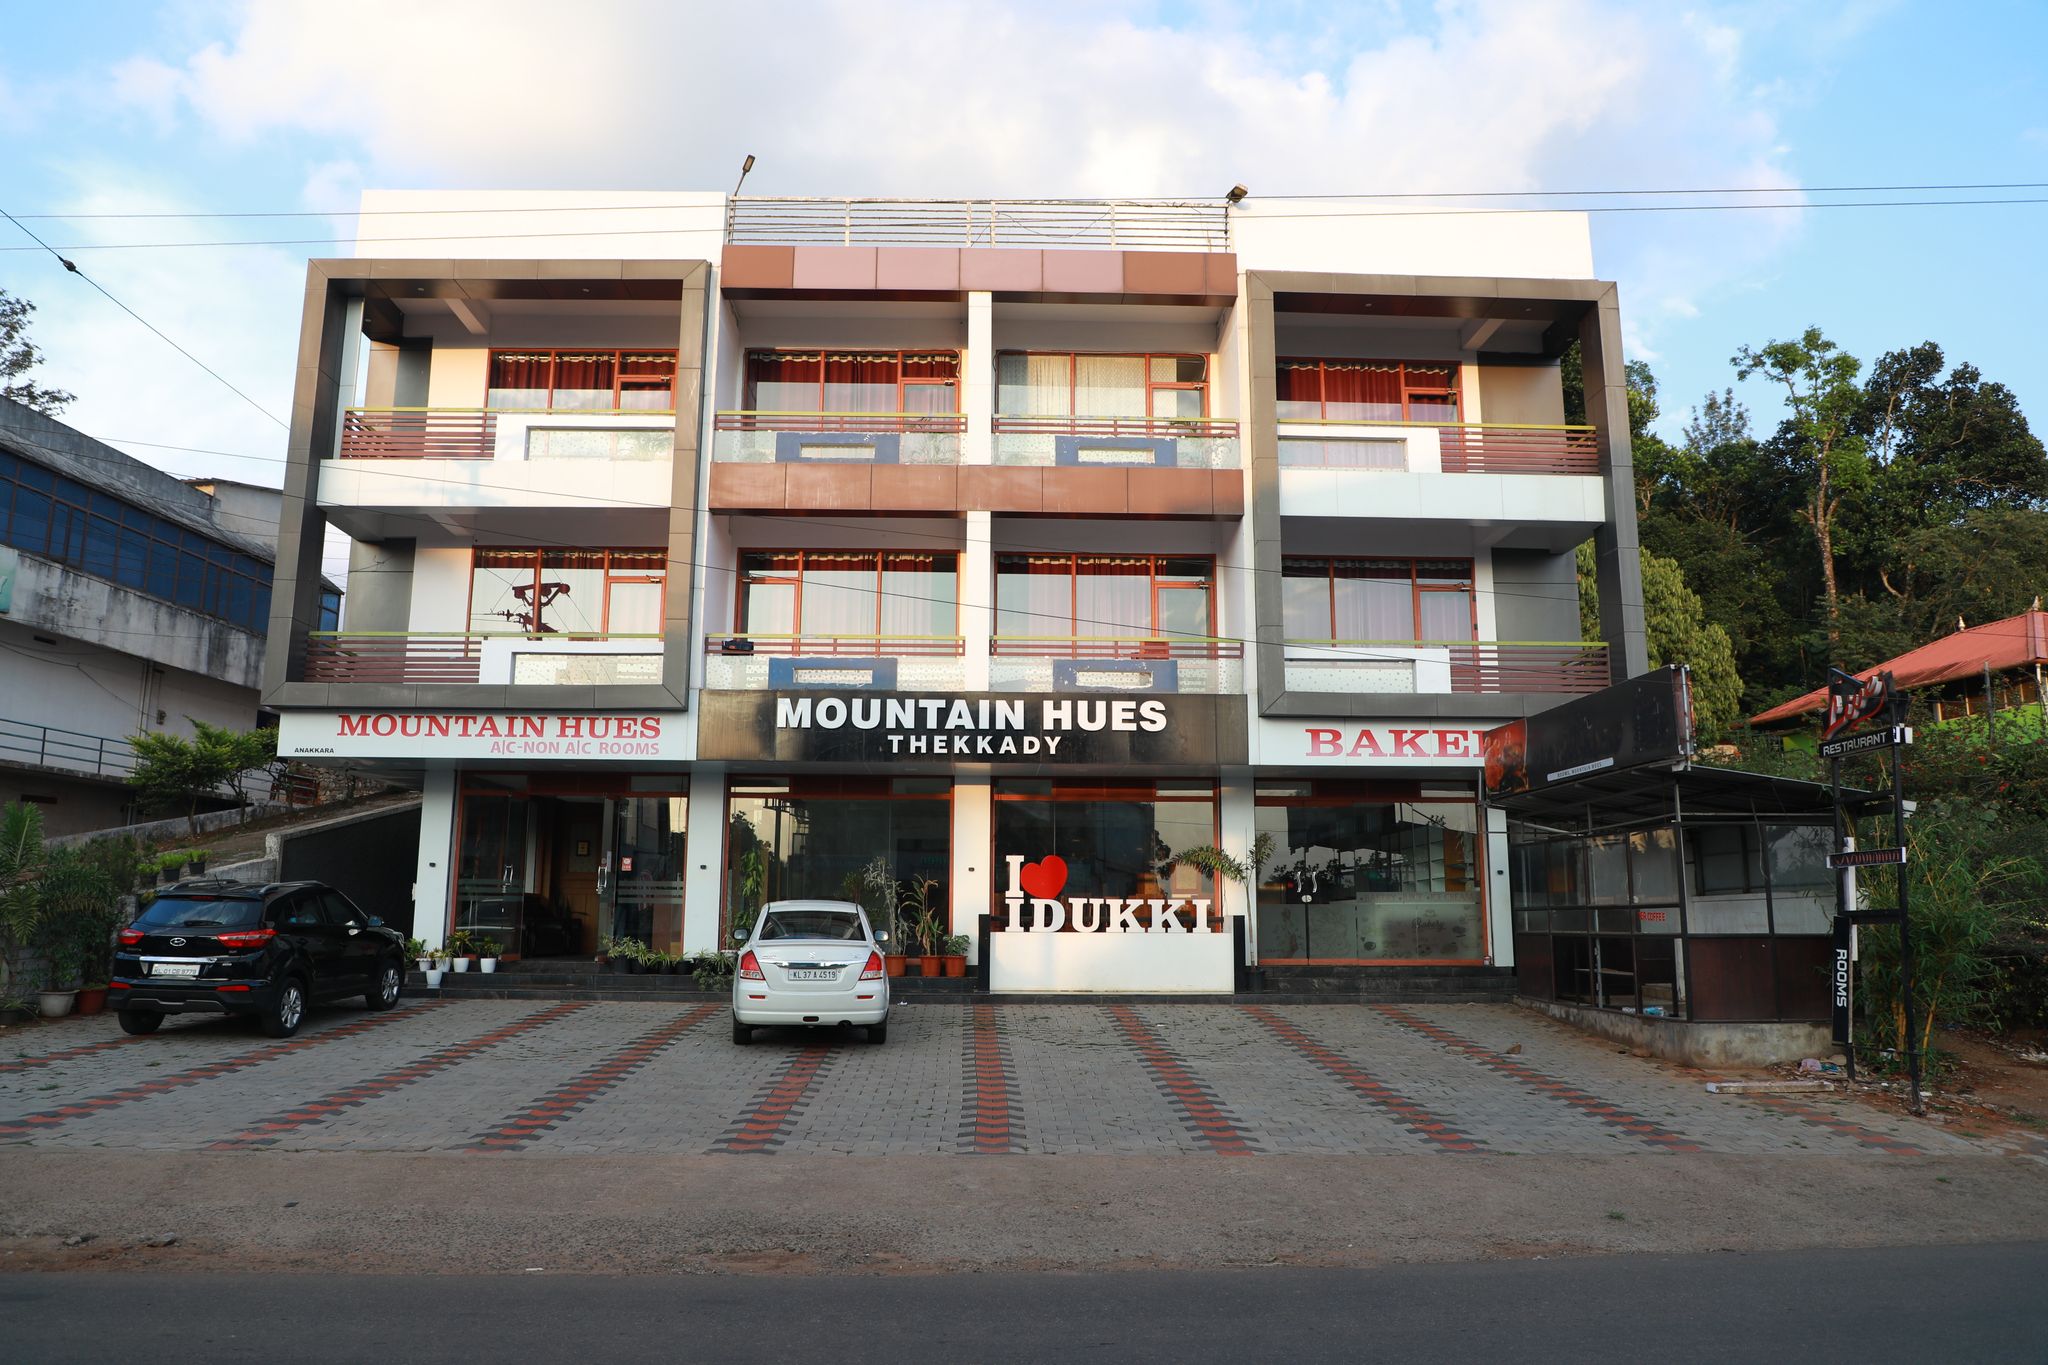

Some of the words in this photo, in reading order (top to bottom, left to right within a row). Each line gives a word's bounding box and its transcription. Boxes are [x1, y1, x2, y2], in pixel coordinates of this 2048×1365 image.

[337, 714, 548, 738] MOUNTAIN
[556, 716, 661, 739] HUES
[776, 697, 1025, 730] MOUNTAIN
[1042, 700, 1167, 732] HUES
[600, 741, 660, 755] ROOMS
[887, 735, 1061, 755] THEKKADY
[1823, 732, 1887, 756] RESTAURANT
[1005, 855, 1025, 898] I
[1005, 898, 1213, 933] IDUKKI
[793, 971, 802, 979] KL
[803, 971, 811, 979] 37
[1836, 948, 1848, 1008] ROOMS
